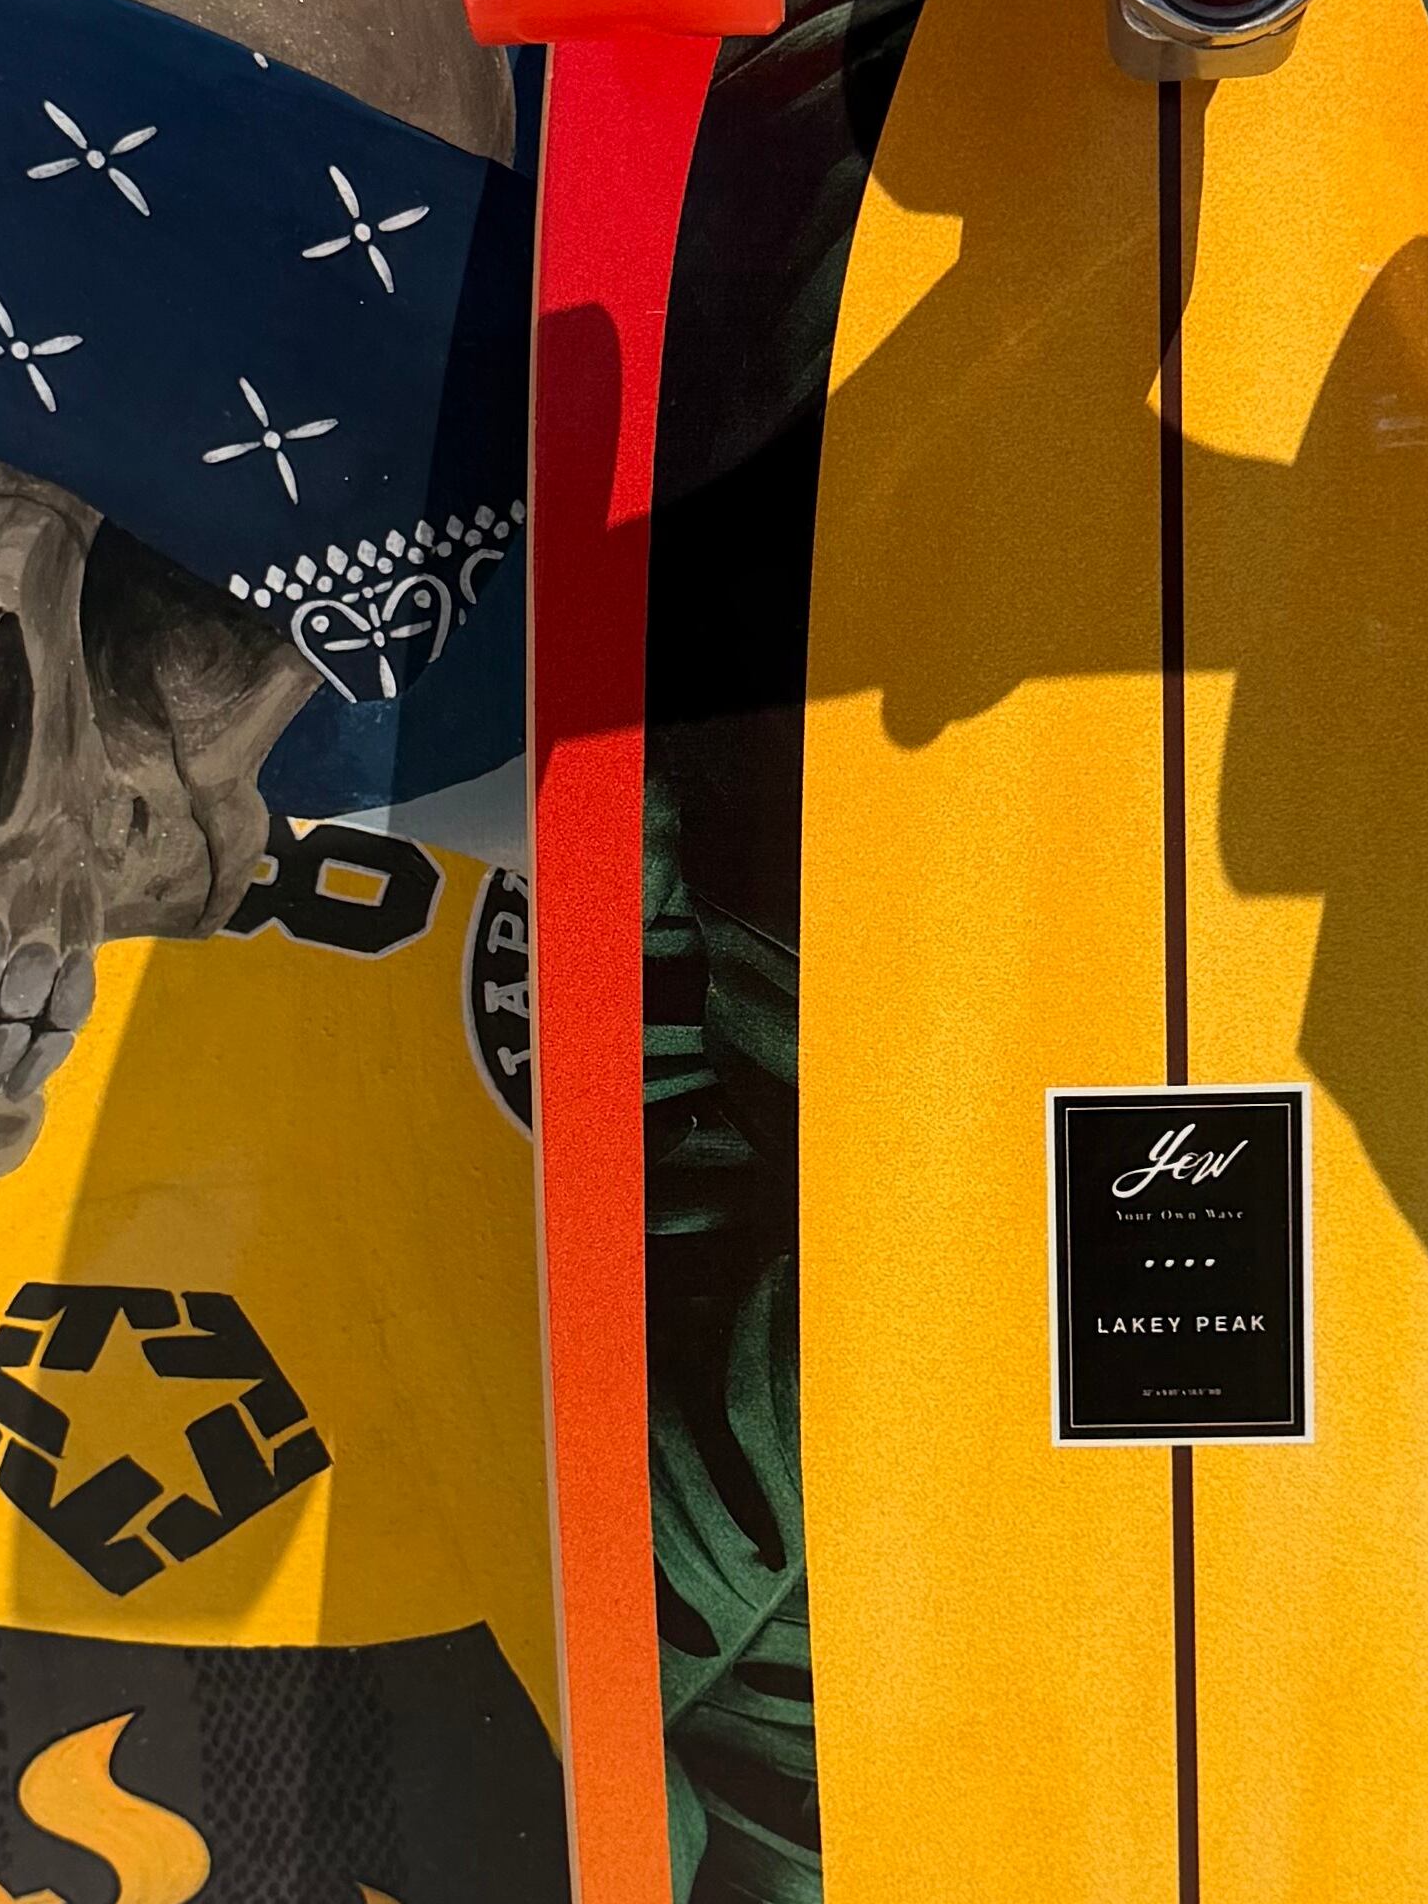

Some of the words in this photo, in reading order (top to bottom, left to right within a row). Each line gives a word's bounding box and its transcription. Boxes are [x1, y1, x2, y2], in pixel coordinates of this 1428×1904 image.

[1160, 1209, 1197, 1221] Own
[1204, 1208, 1245, 1220] Wave
[1096, 1316, 1181, 1335] LAKEY
[1195, 1314, 1267, 1333] PEAK
